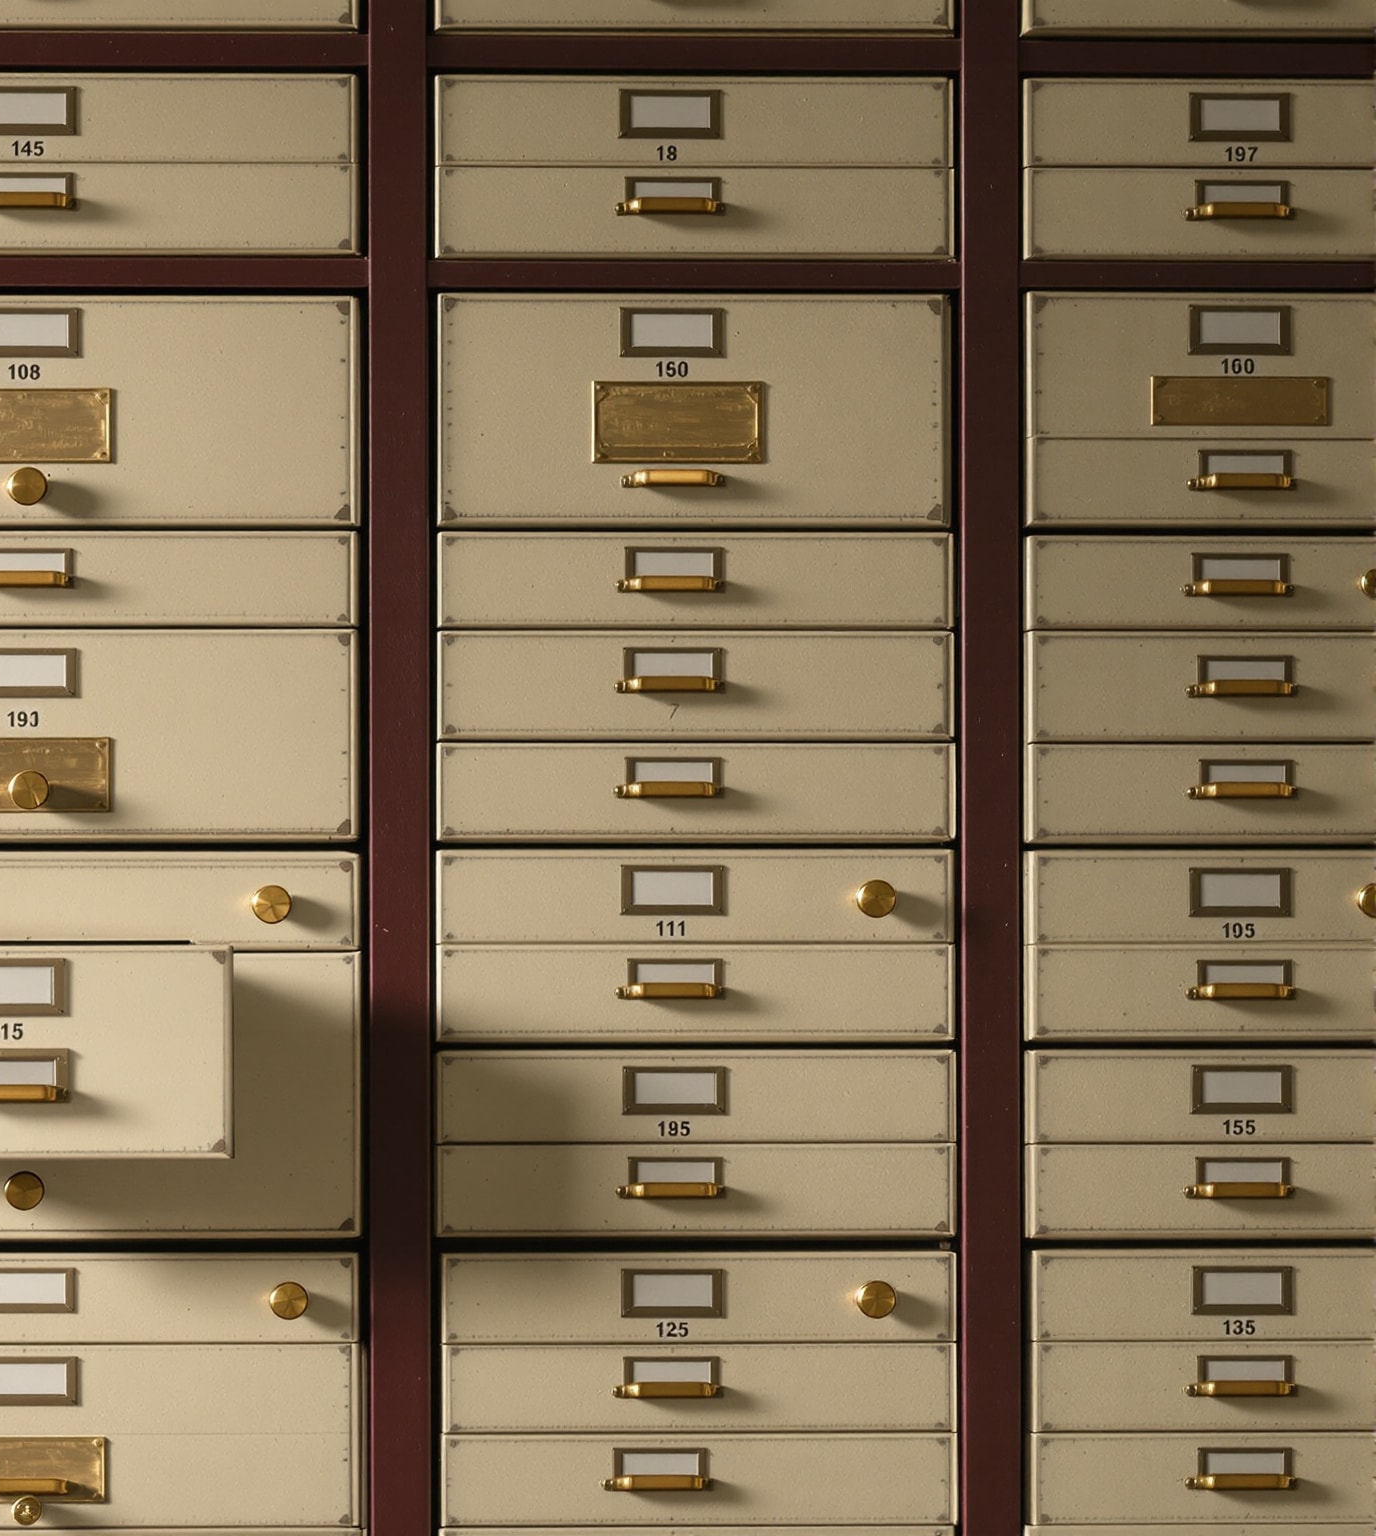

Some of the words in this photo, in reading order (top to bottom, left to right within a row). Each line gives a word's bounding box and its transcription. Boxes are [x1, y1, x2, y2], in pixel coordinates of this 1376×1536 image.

[11, 139, 44, 156] 145
[656, 144, 677, 161] 18
[1224, 146, 1258, 162] 197
[7, 363, 40, 380] 108
[655, 920, 685, 936] 111
[1222, 1119, 1255, 1135] 155
[655, 1321, 688, 1337] 125
[1223, 1319, 1255, 1335] 135
